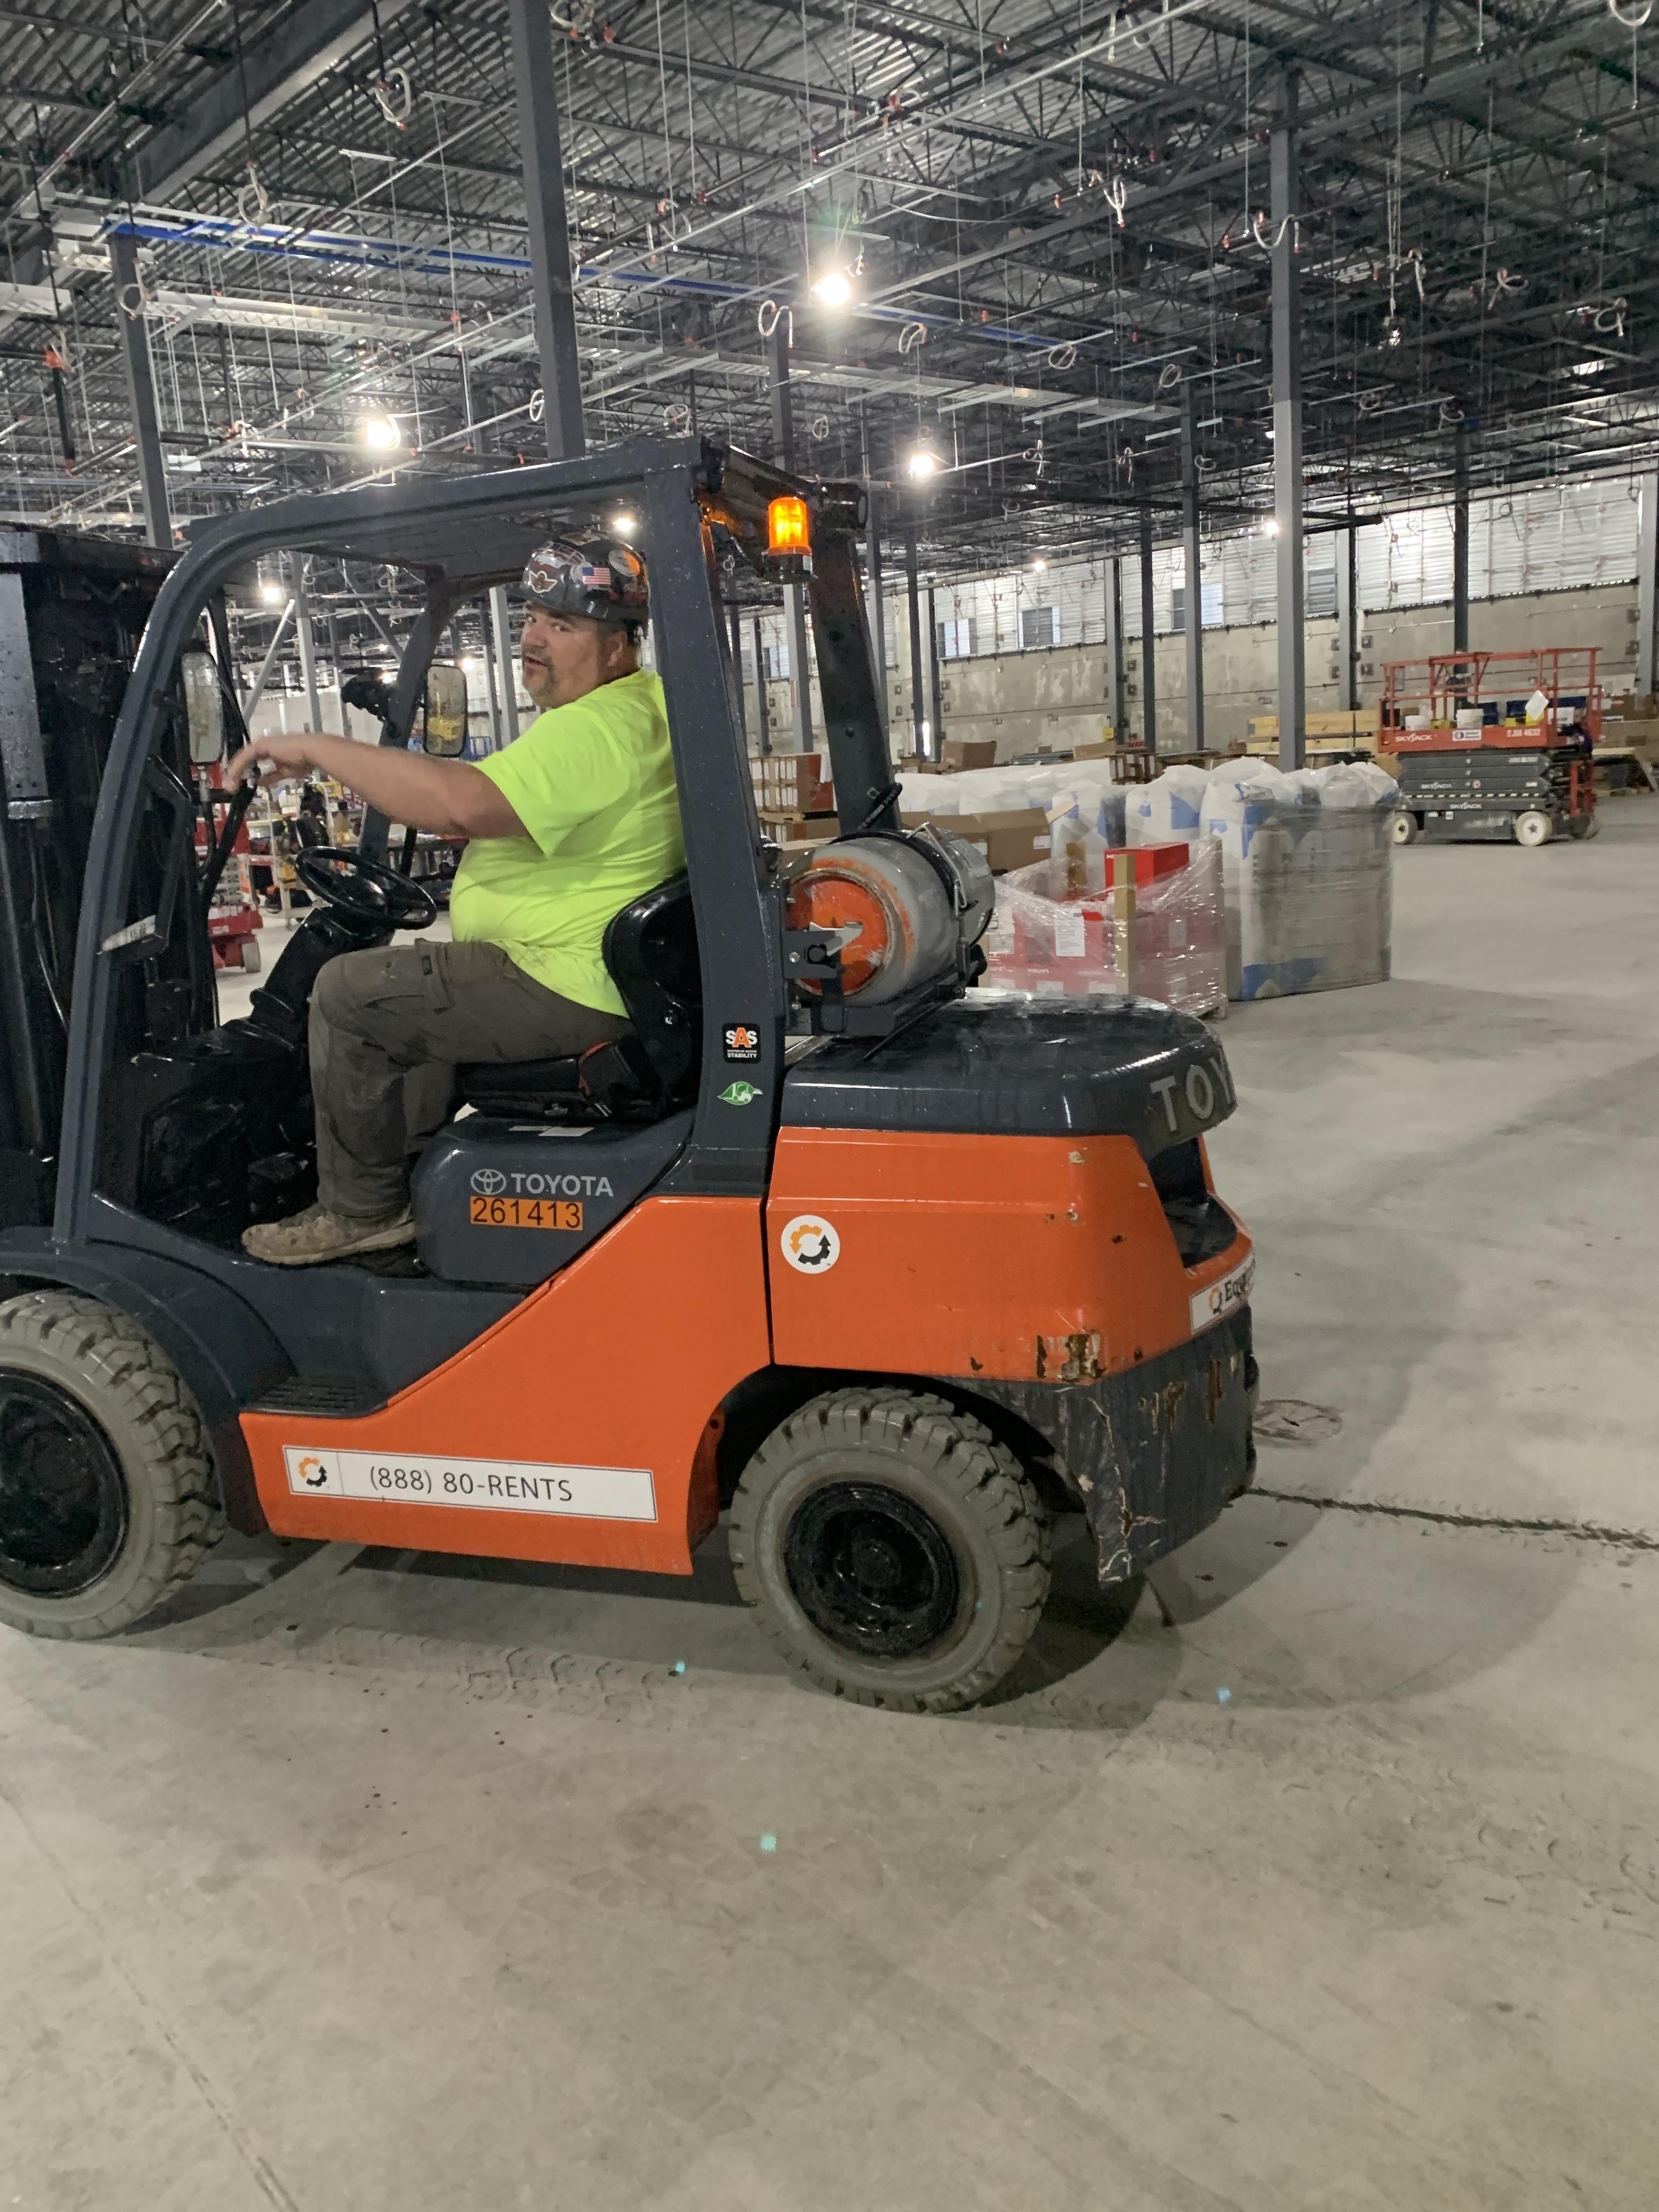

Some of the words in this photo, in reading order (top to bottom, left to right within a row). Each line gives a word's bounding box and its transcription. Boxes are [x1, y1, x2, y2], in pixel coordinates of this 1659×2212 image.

[1395, 733, 1432, 742] SKYJACK
[726, 1027, 758, 1048] SAS
[510, 1173, 613, 1197] TOYOTA
[472, 1197, 580, 1228] 261413
[369, 1466, 432, 1493] (888)
[443, 1472, 573, 1502] 80-RENTS
